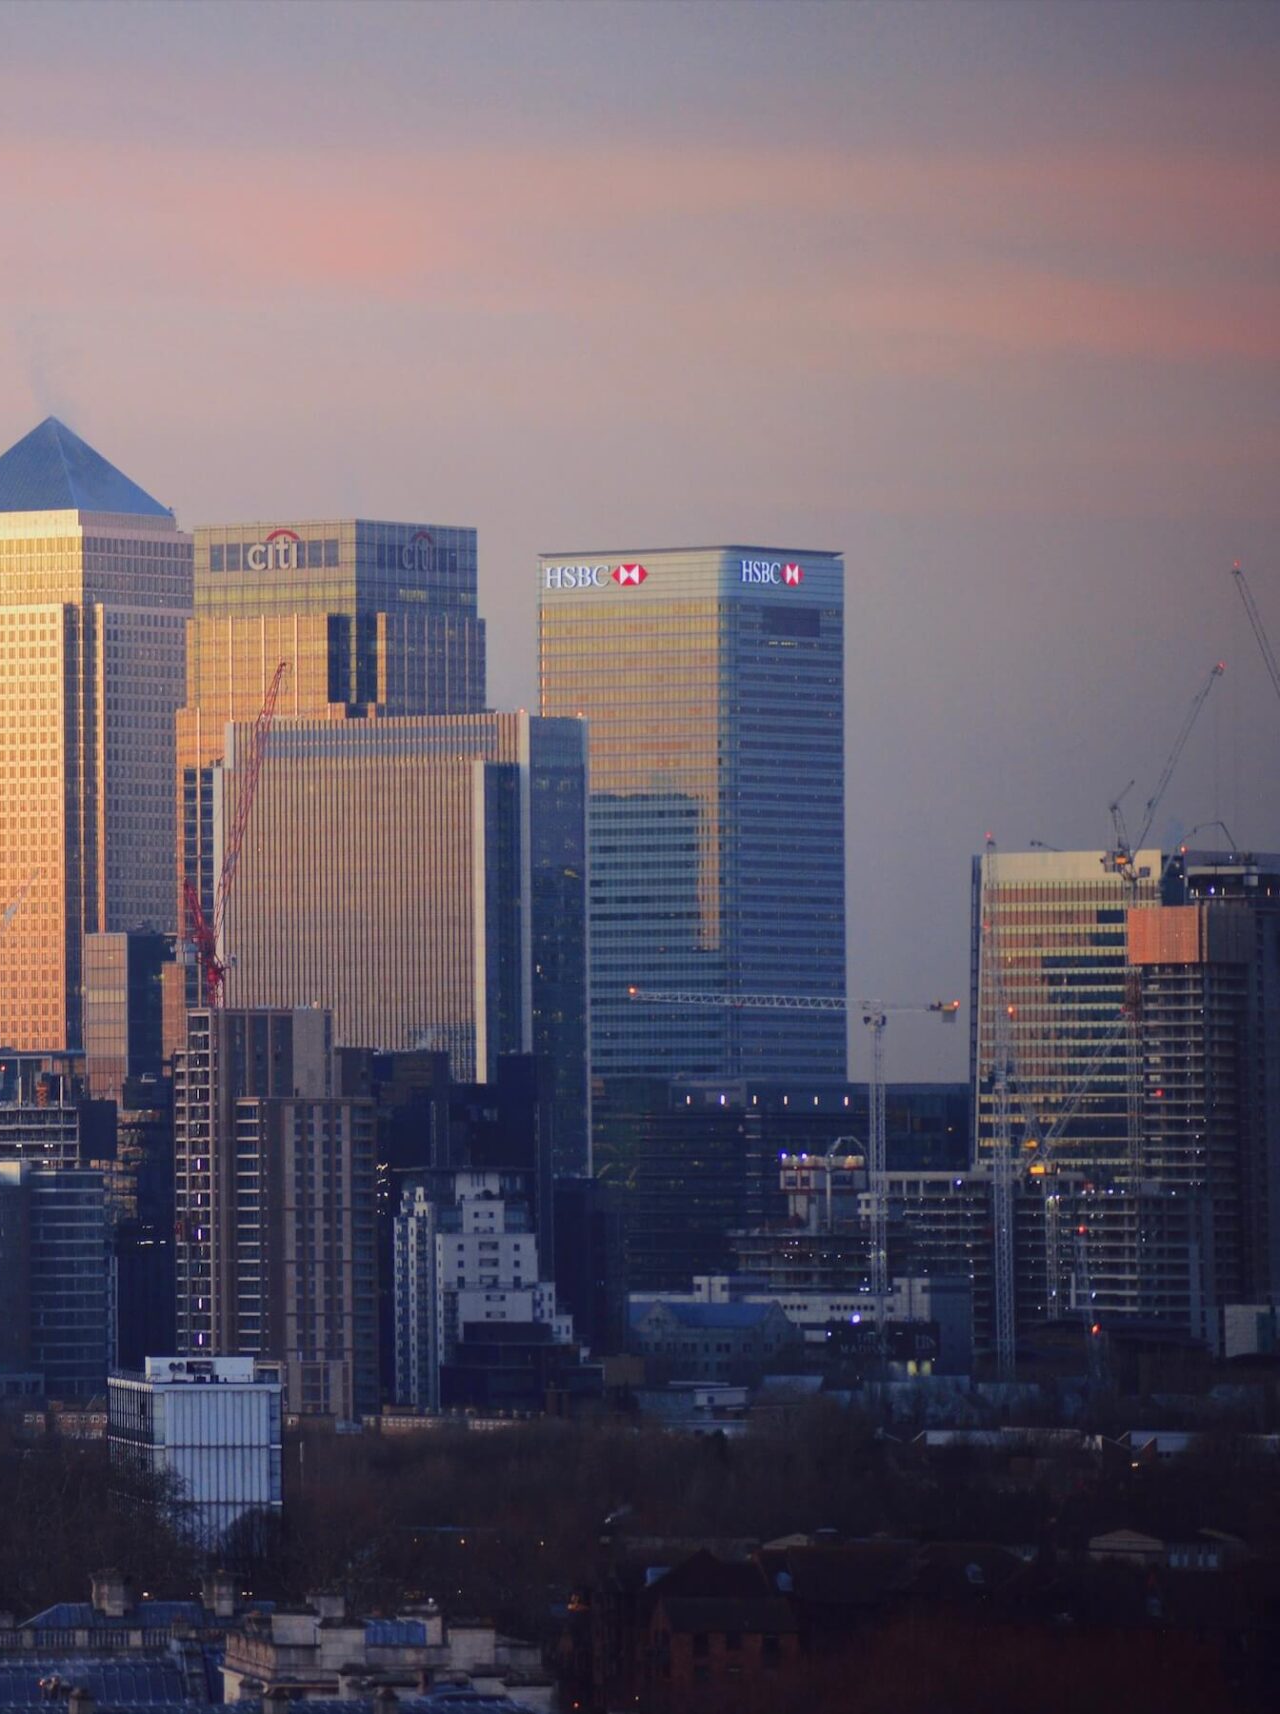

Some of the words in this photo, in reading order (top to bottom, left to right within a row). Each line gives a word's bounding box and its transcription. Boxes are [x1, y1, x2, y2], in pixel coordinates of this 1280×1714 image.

[247, 536, 298, 571] citi
[546, 565, 610, 588] HSBC
[740, 560, 781, 585] HSBC
